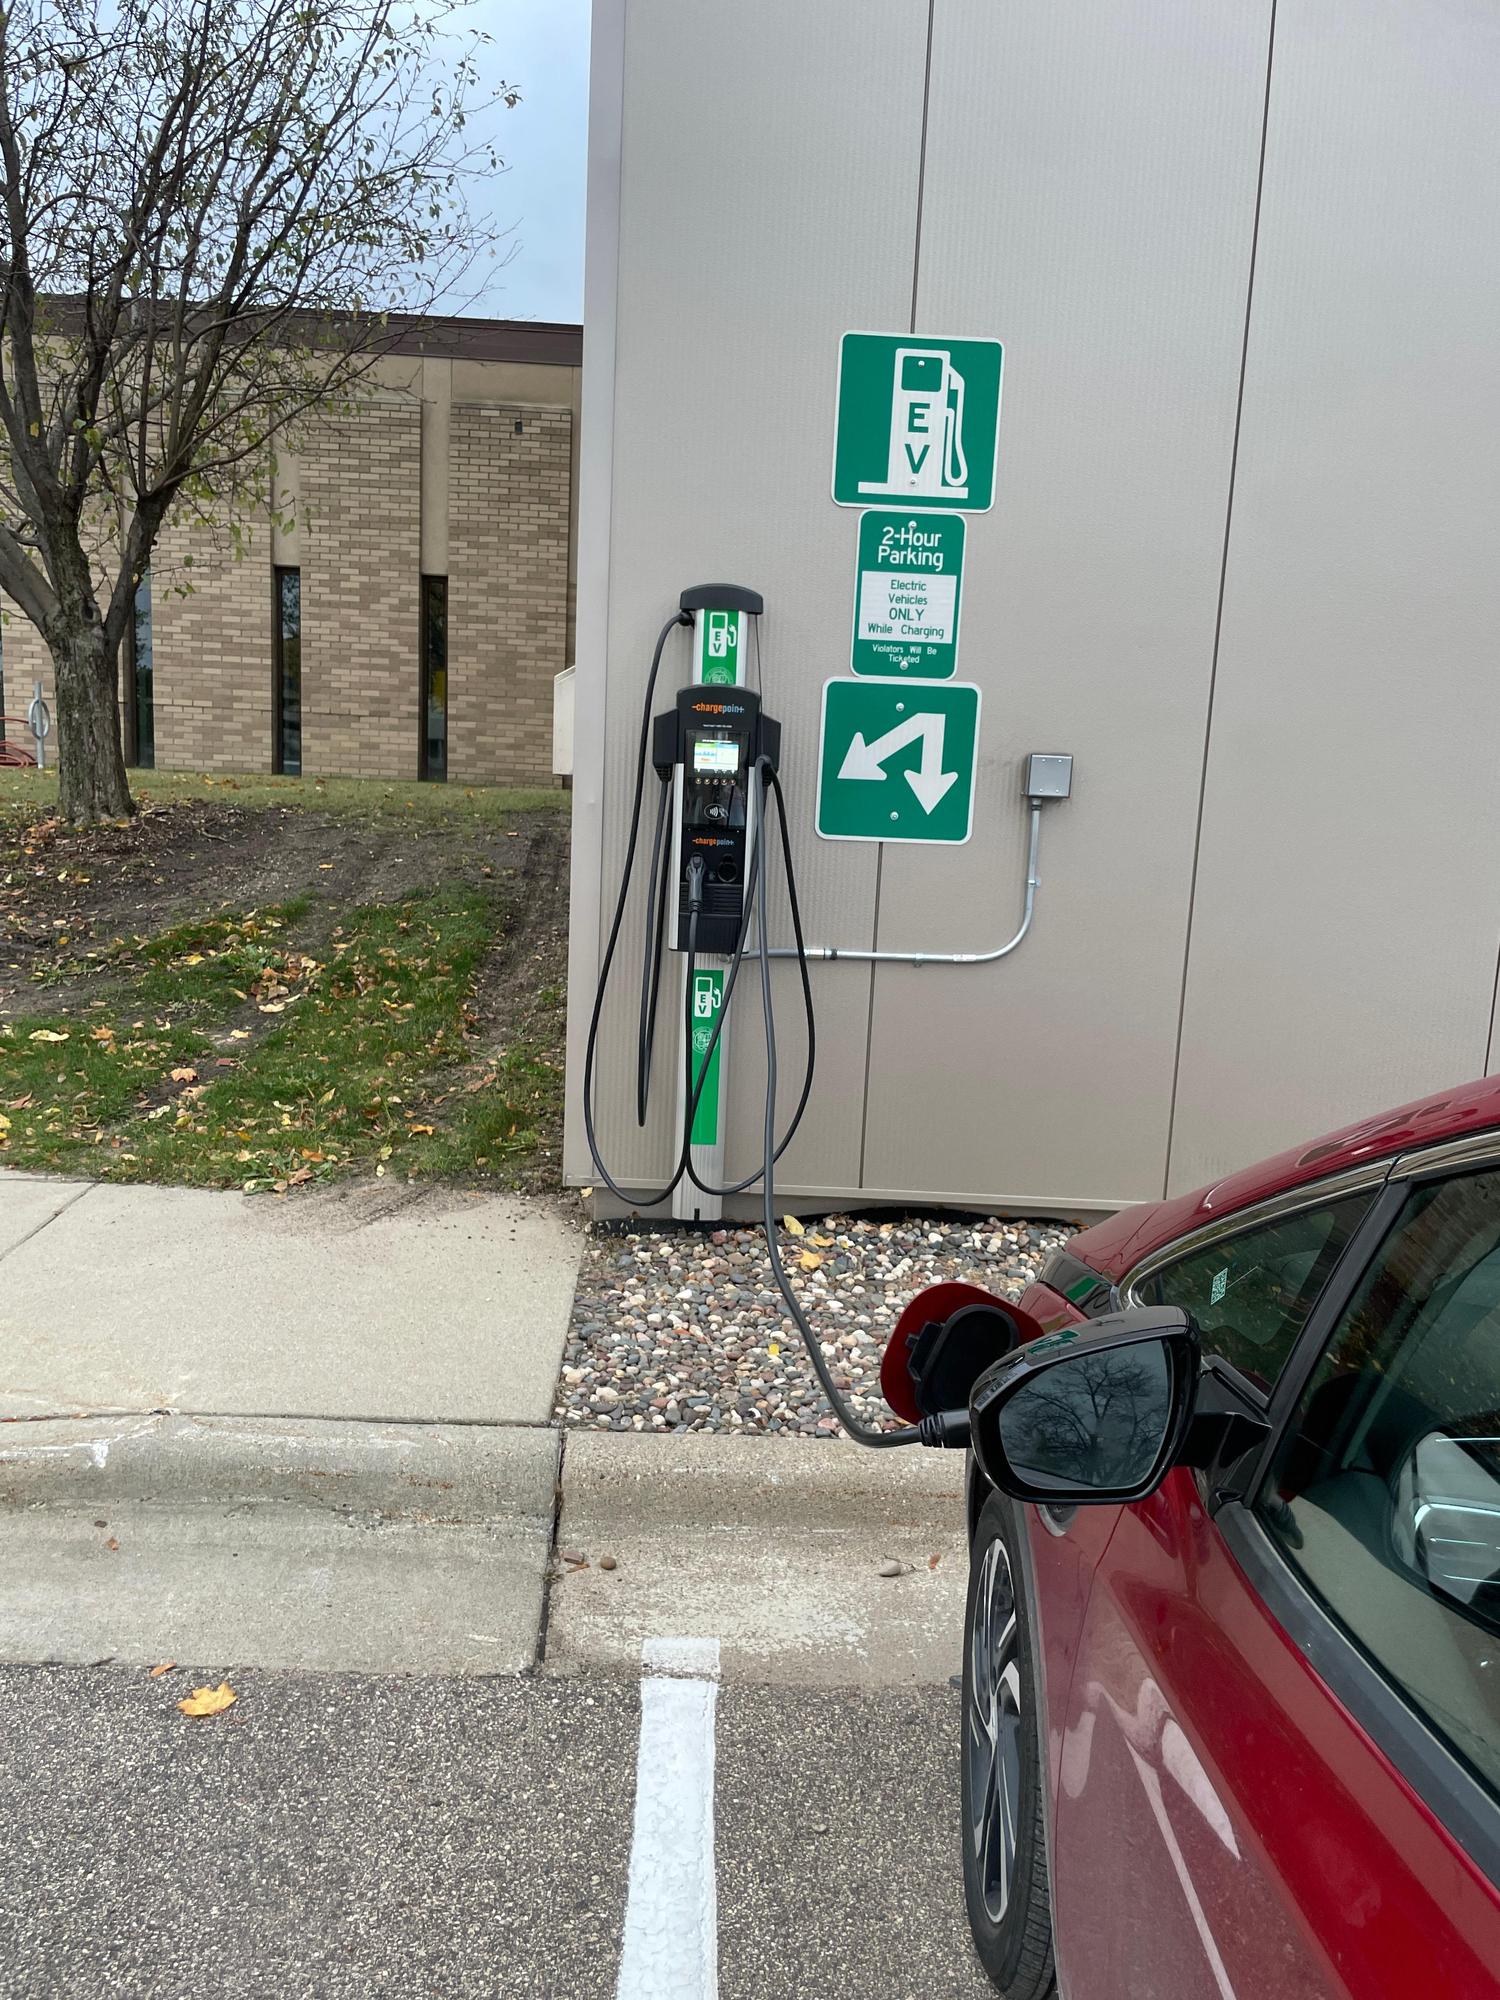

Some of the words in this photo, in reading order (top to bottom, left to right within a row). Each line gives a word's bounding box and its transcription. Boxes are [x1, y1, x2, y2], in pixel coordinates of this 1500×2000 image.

[881, 526, 942, 547] 2-Hour
[878, 546, 944, 572] Parking
[890, 579, 927, 592] Electric
[888, 593, 928, 606] Vehicles
[889, 608, 925, 621] ONLY
[868, 623, 893, 634] While
[901, 625, 944, 640] Charging
[872, 644, 904, 654] Violators
[909, 645, 922, 654] Will
[926, 646, 938, 655] Be
[889, 653, 920, 664] Ticketed
